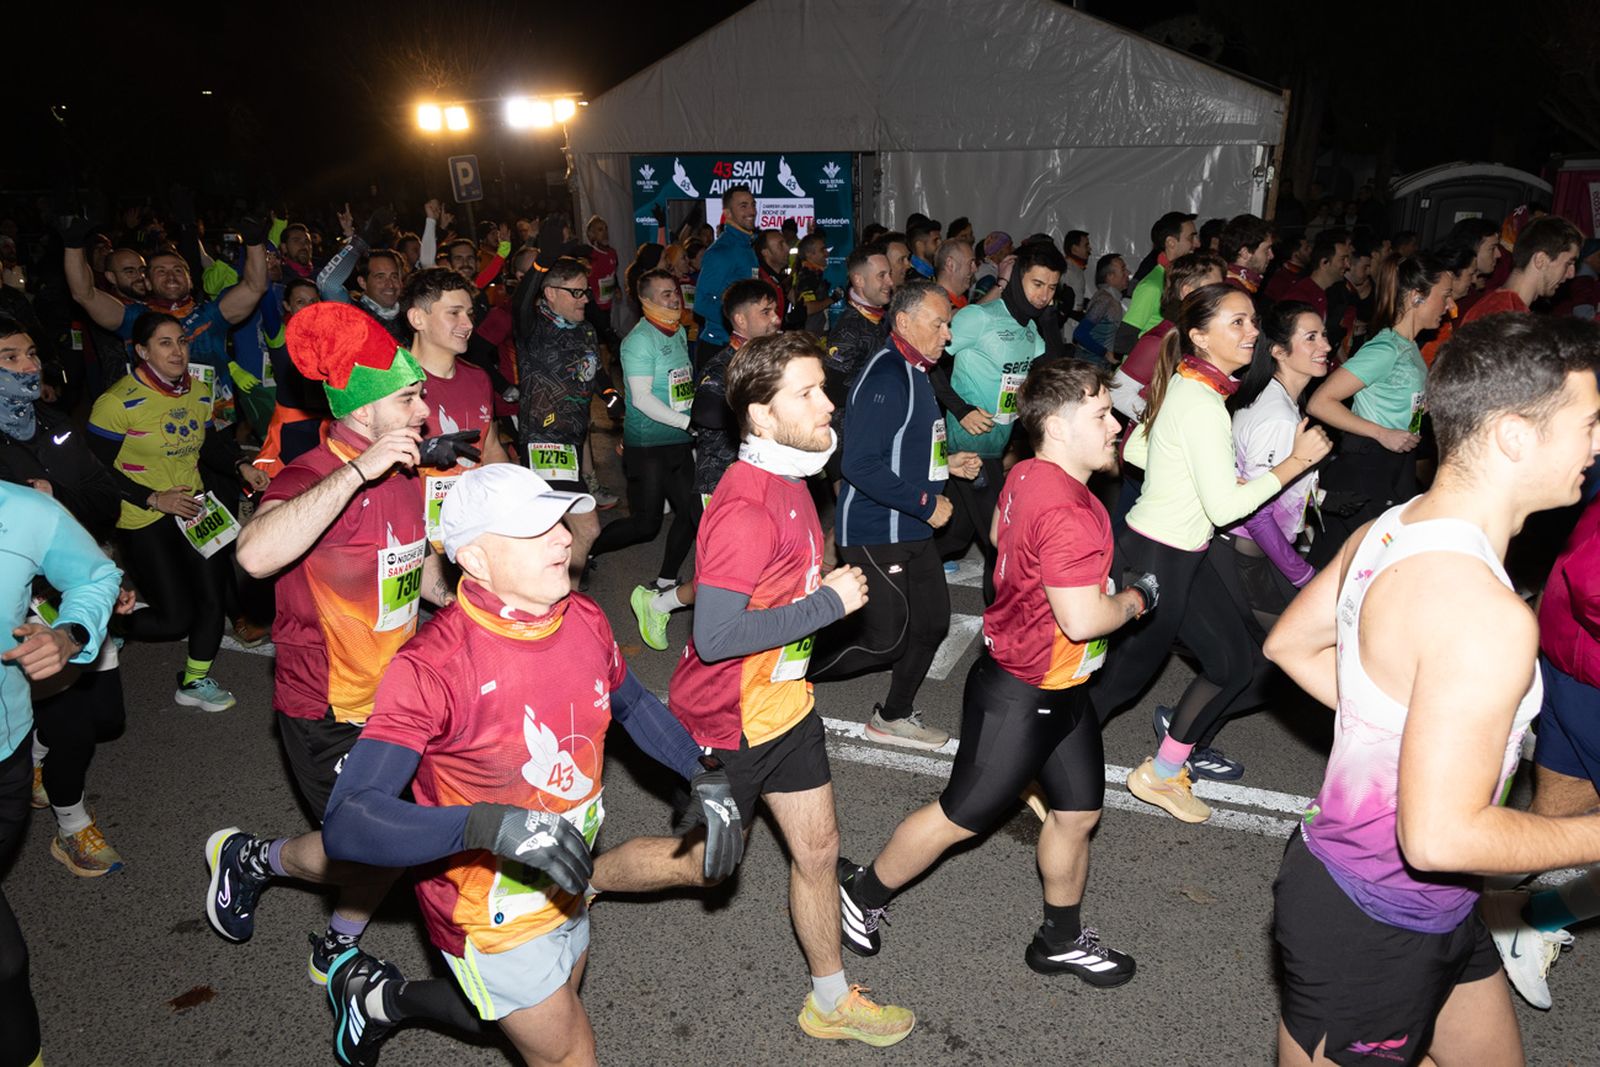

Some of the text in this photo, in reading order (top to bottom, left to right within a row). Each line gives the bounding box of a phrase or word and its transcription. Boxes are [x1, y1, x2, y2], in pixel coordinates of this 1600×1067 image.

[456, 162, 473, 186] P
[713, 161, 765, 178] 43 SAN
[760, 215, 785, 227] SAN
[539, 450, 568, 465] 7275
[547, 762, 574, 792] 43
